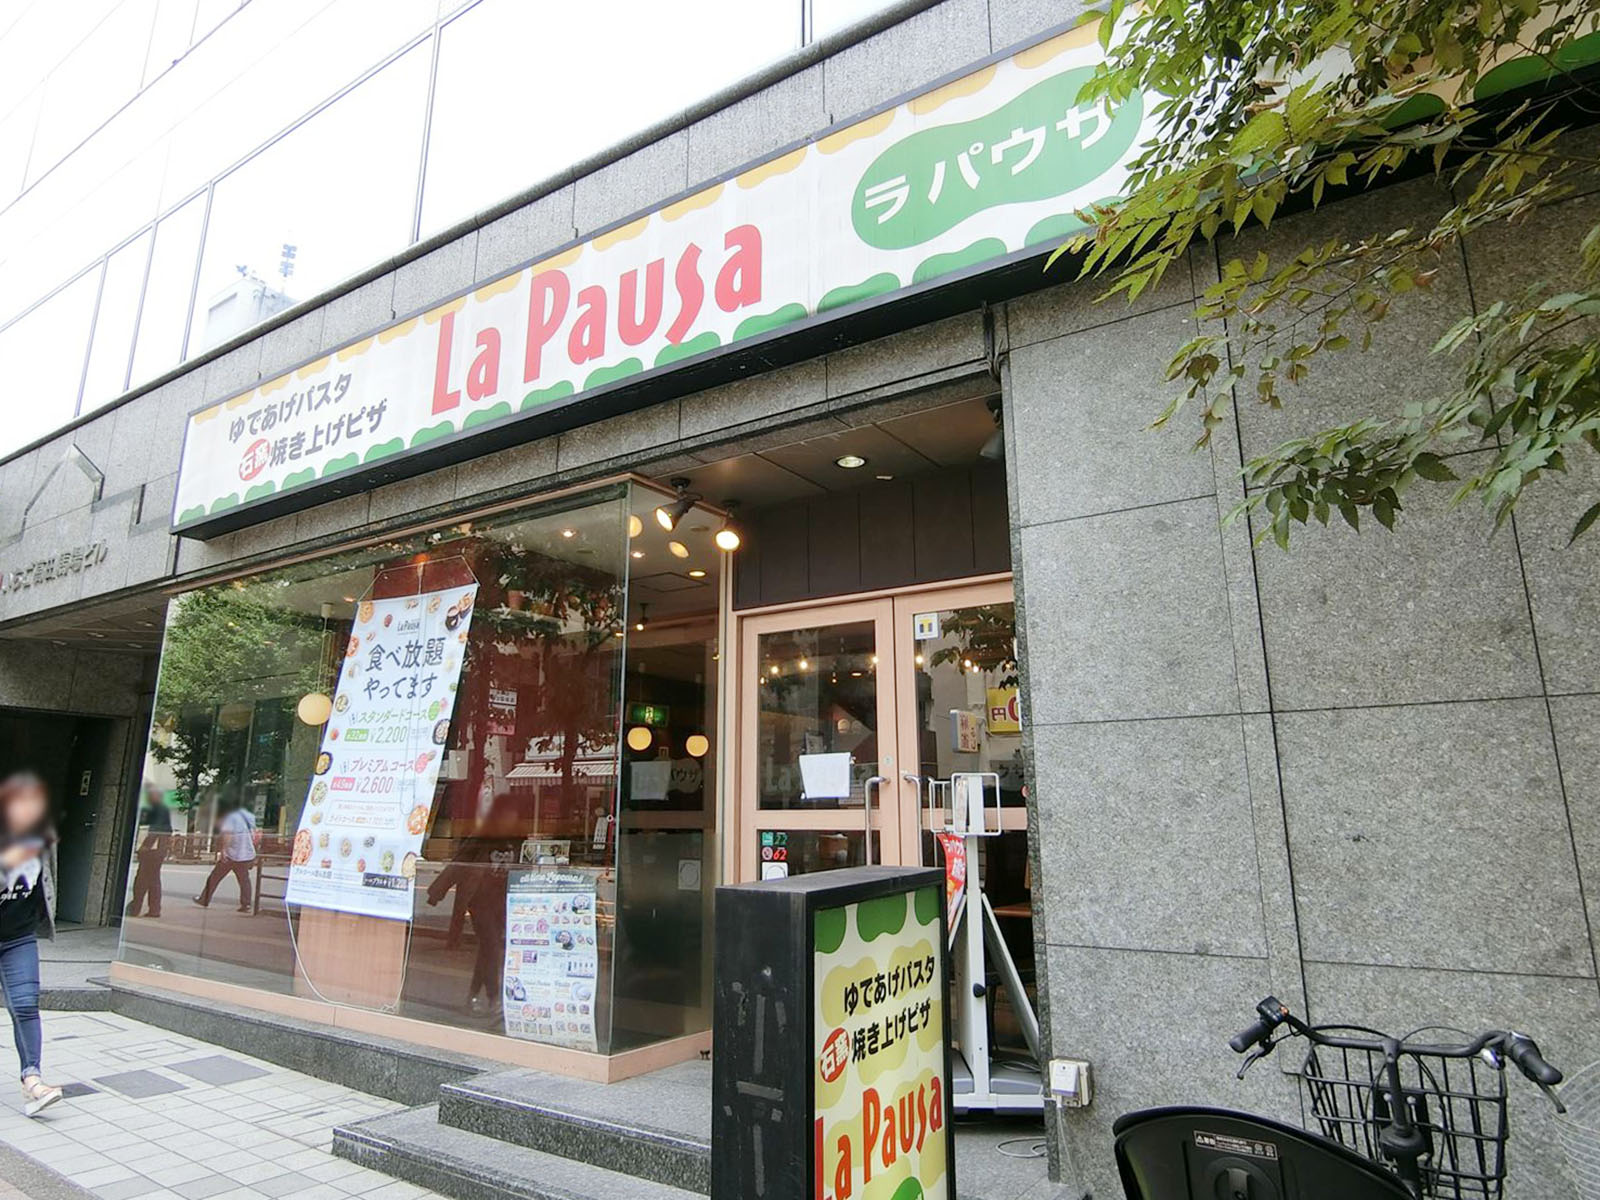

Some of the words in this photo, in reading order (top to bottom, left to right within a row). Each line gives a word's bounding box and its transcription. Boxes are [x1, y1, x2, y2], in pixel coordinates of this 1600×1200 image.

[431, 310, 501, 416] La
[523, 224, 763, 384] Pausa
[229, 373, 352, 444] ゆであげパスタ
[269, 398, 387, 468] 焼き上げピザ
[363, 673, 438, 701] やってます
[365, 637, 446, 672] 食べ放題
[843, 955, 935, 1016] ゆであげパスタ
[852, 997, 931, 1064] 焼き上げピザ
[815, 1116, 852, 1200] La
[862, 1076, 943, 1185] Pausa
